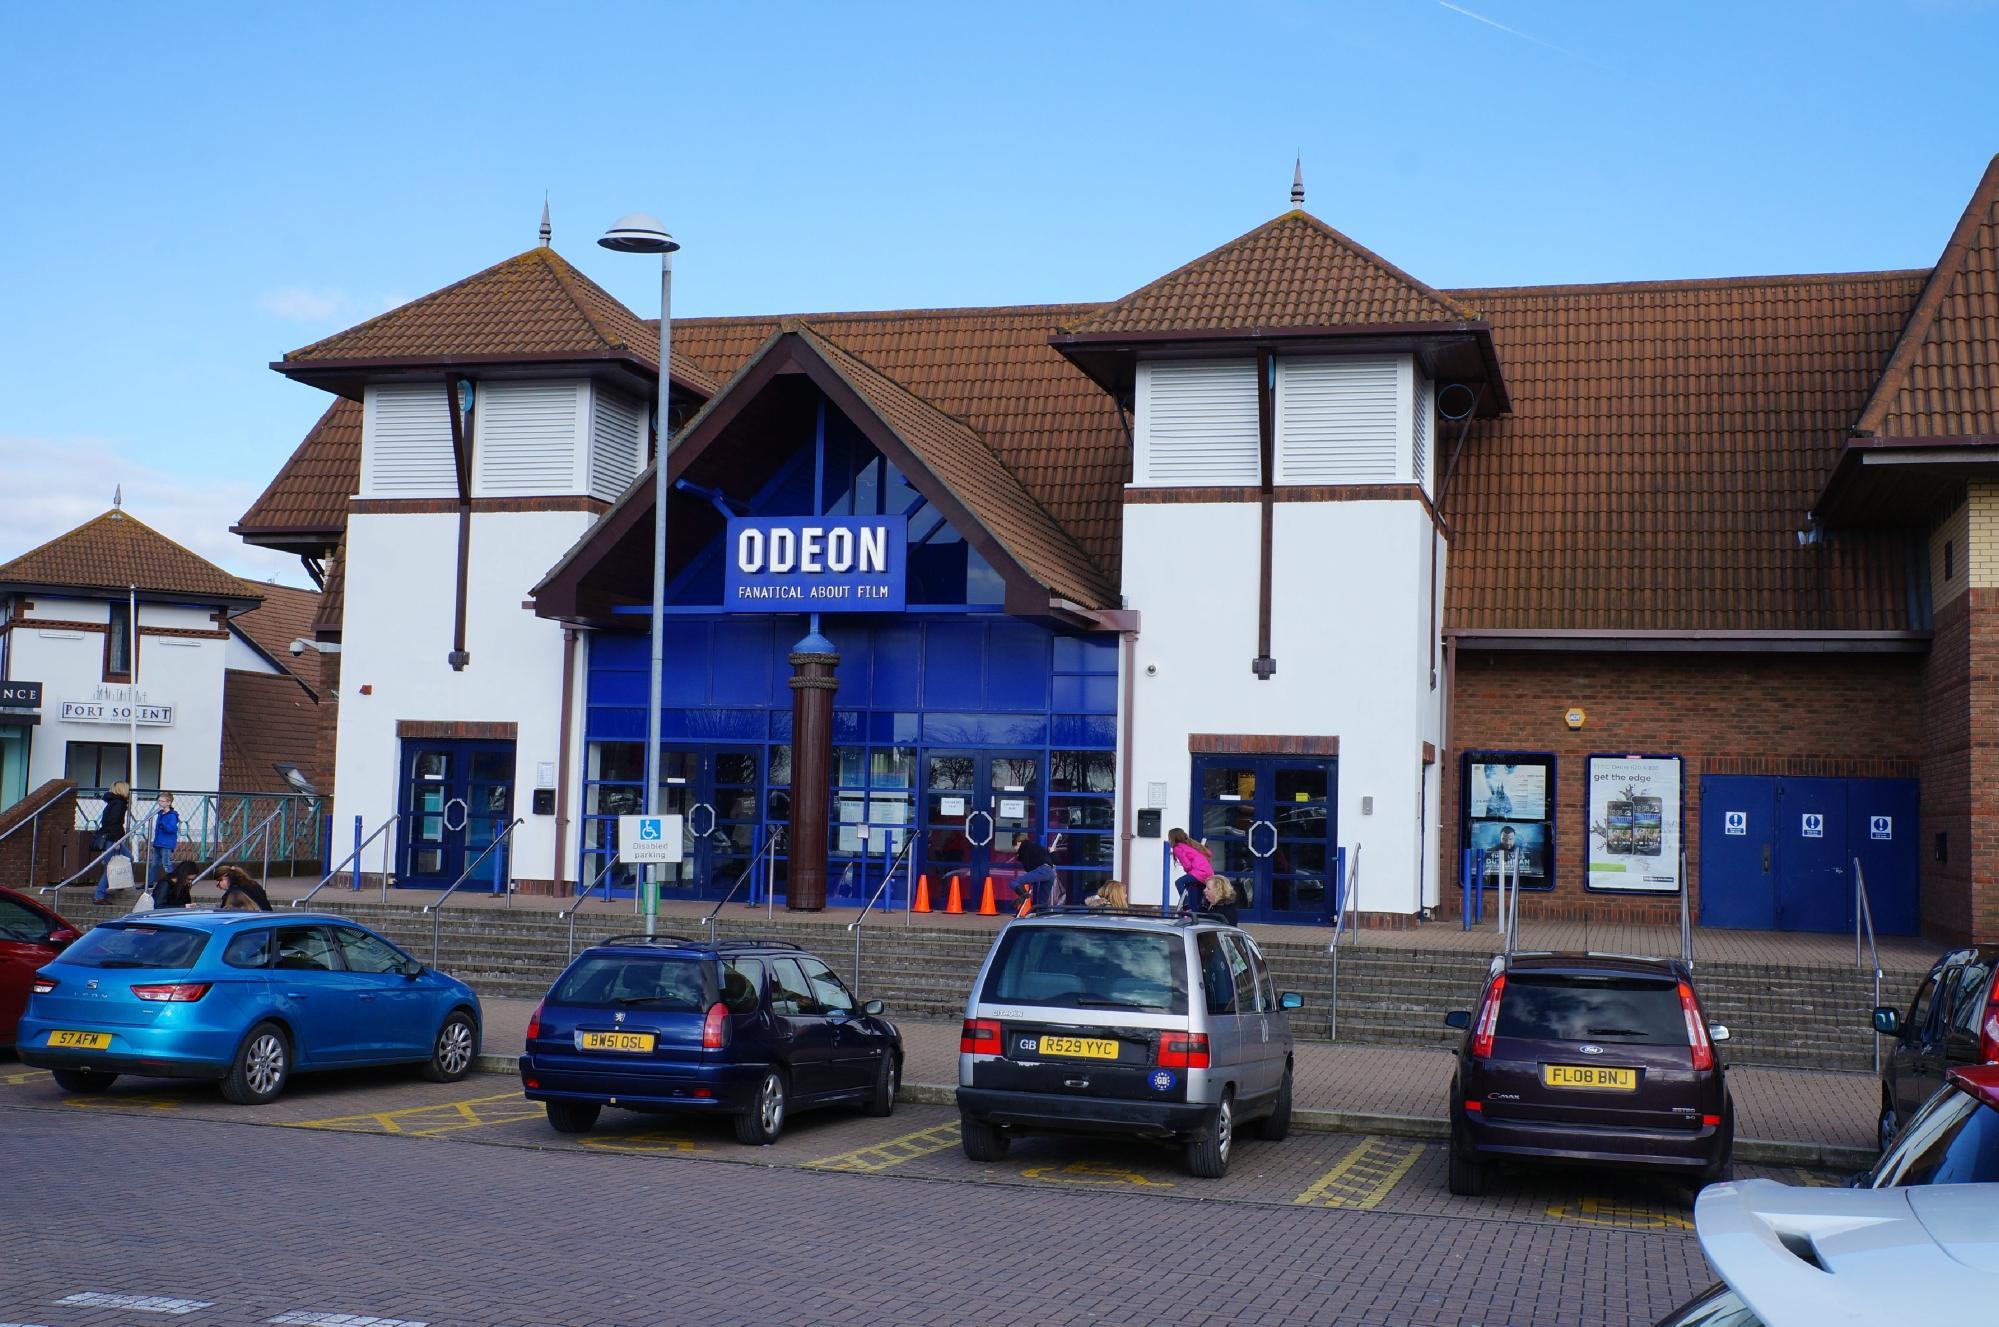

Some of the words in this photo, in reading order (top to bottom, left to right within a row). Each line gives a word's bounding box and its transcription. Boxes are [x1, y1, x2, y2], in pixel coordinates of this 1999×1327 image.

[738, 527, 887, 573] ODEON
[738, 586, 804, 599] FANATICAL
[810, 586, 850, 598] ABOUT
[857, 585, 888, 598] FILM
[3, 689, 37, 700] NCE
[65, 704, 105, 717] PORT
[112, 706, 170, 720] SOENT
[1593, 774, 1609, 782] get
[1611, 773, 1626, 781] the
[1628, 774, 1651, 783] edge
[633, 842, 669, 850] Disabled
[634, 851, 666, 860] parking
[75, 1033, 99, 1046] AFM
[1019, 1038, 1037, 1050] GB
[1046, 1038, 1082, 1053] R529
[1086, 1042, 1113, 1056] YYC
[1156, 1075, 1168, 1086] GB
[1552, 1068, 1593, 1082] FL08
[1598, 1070, 1628, 1085] BNJ
